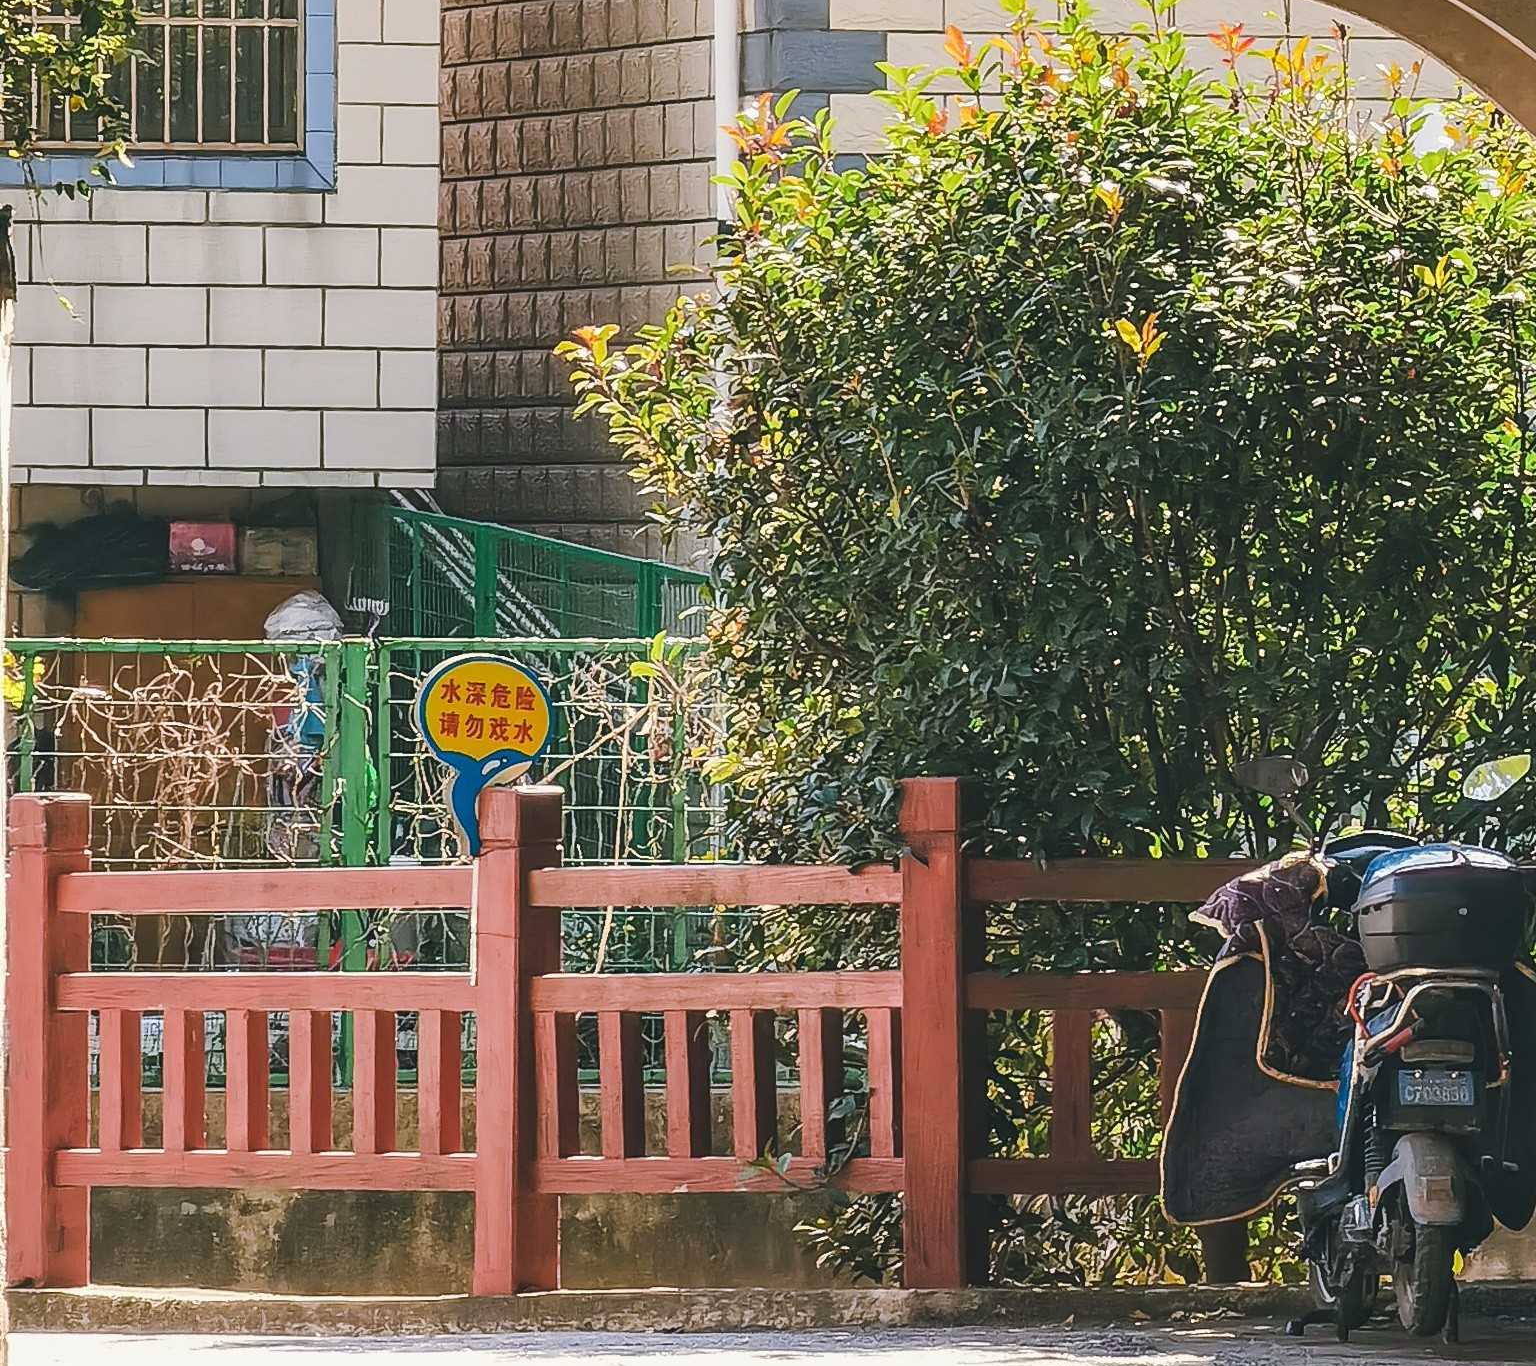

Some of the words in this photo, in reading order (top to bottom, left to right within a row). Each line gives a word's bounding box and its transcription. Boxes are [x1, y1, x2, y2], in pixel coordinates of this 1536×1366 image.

[440, 678, 537, 712] 水深危险
[438, 711, 534, 744] 请勿戏水
